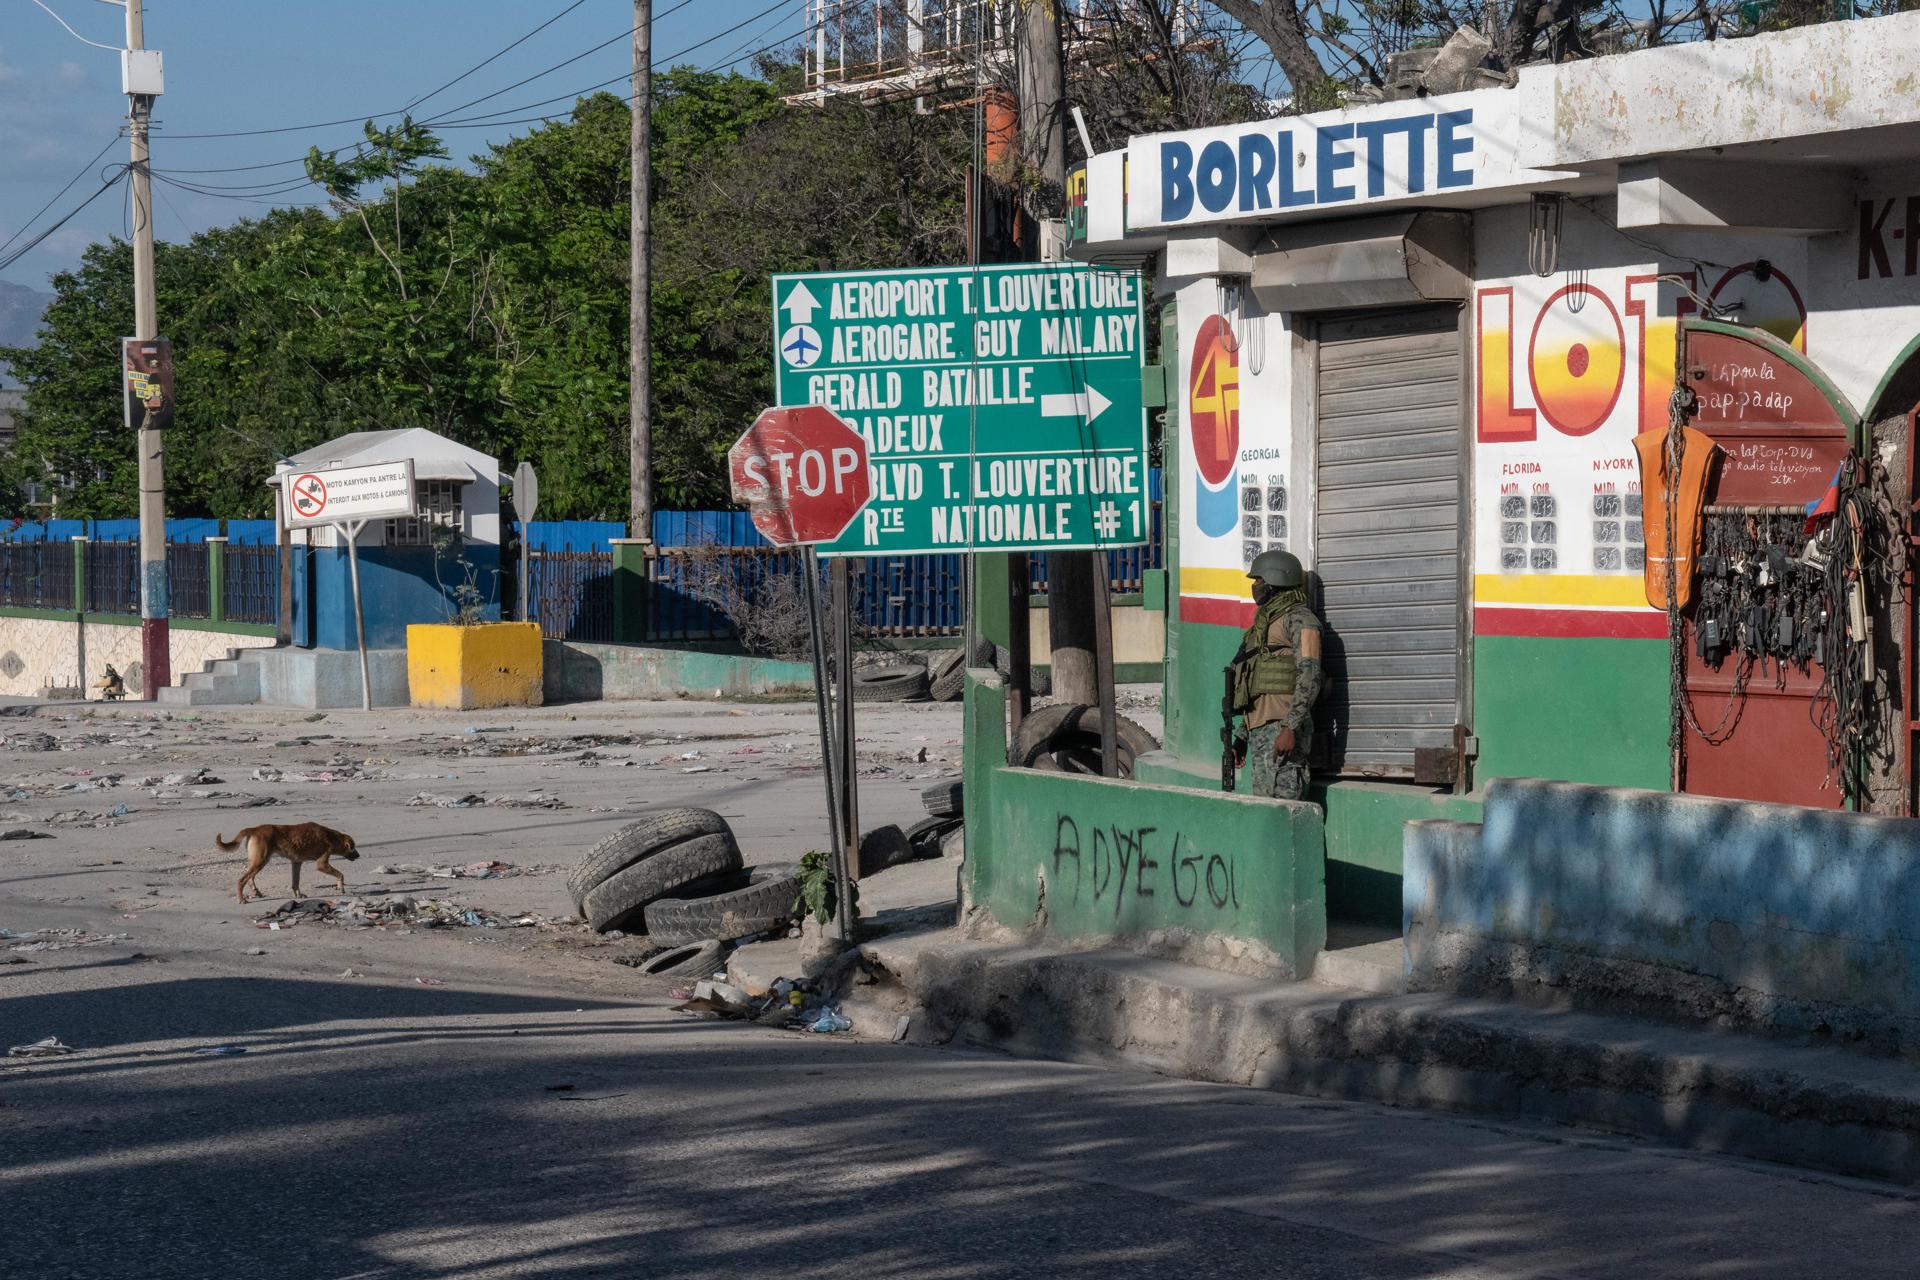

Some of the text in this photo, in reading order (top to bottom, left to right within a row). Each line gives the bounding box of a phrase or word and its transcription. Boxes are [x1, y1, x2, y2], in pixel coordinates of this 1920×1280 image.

[1161, 108, 1474, 222] BORLETTE
[829, 278, 949, 320] AEROPORT
[984, 270, 1137, 313] LOUVERTURE
[831, 314, 1136, 364] AEROGARE GUY MALARY
[808, 366, 1035, 411] GERALD BATAILLE
[743, 447, 859, 500] STOP
[1241, 448, 1280, 462] GEORGIA
[1503, 463, 1541, 475] FLORIDA
[326, 481, 342, 489] MOTO
[343, 478, 368, 487] KAMYON
[378, 474, 397, 482] ANTRE
[398, 472, 406, 480] LA
[328, 495, 350, 504] INTERDIT
[362, 492, 379, 500] MOTOS
[384, 488, 408, 497] CAMIONS
[939, 461, 959, 499] T.
[975, 456, 1139, 497] LOUVERTURE
[1268, 473, 1284, 486] SOIR
[1532, 482, 1550, 494] SOIR
[931, 503, 1072, 545] NATIONALE
[1053, 811, 1158, 919] ADYE
